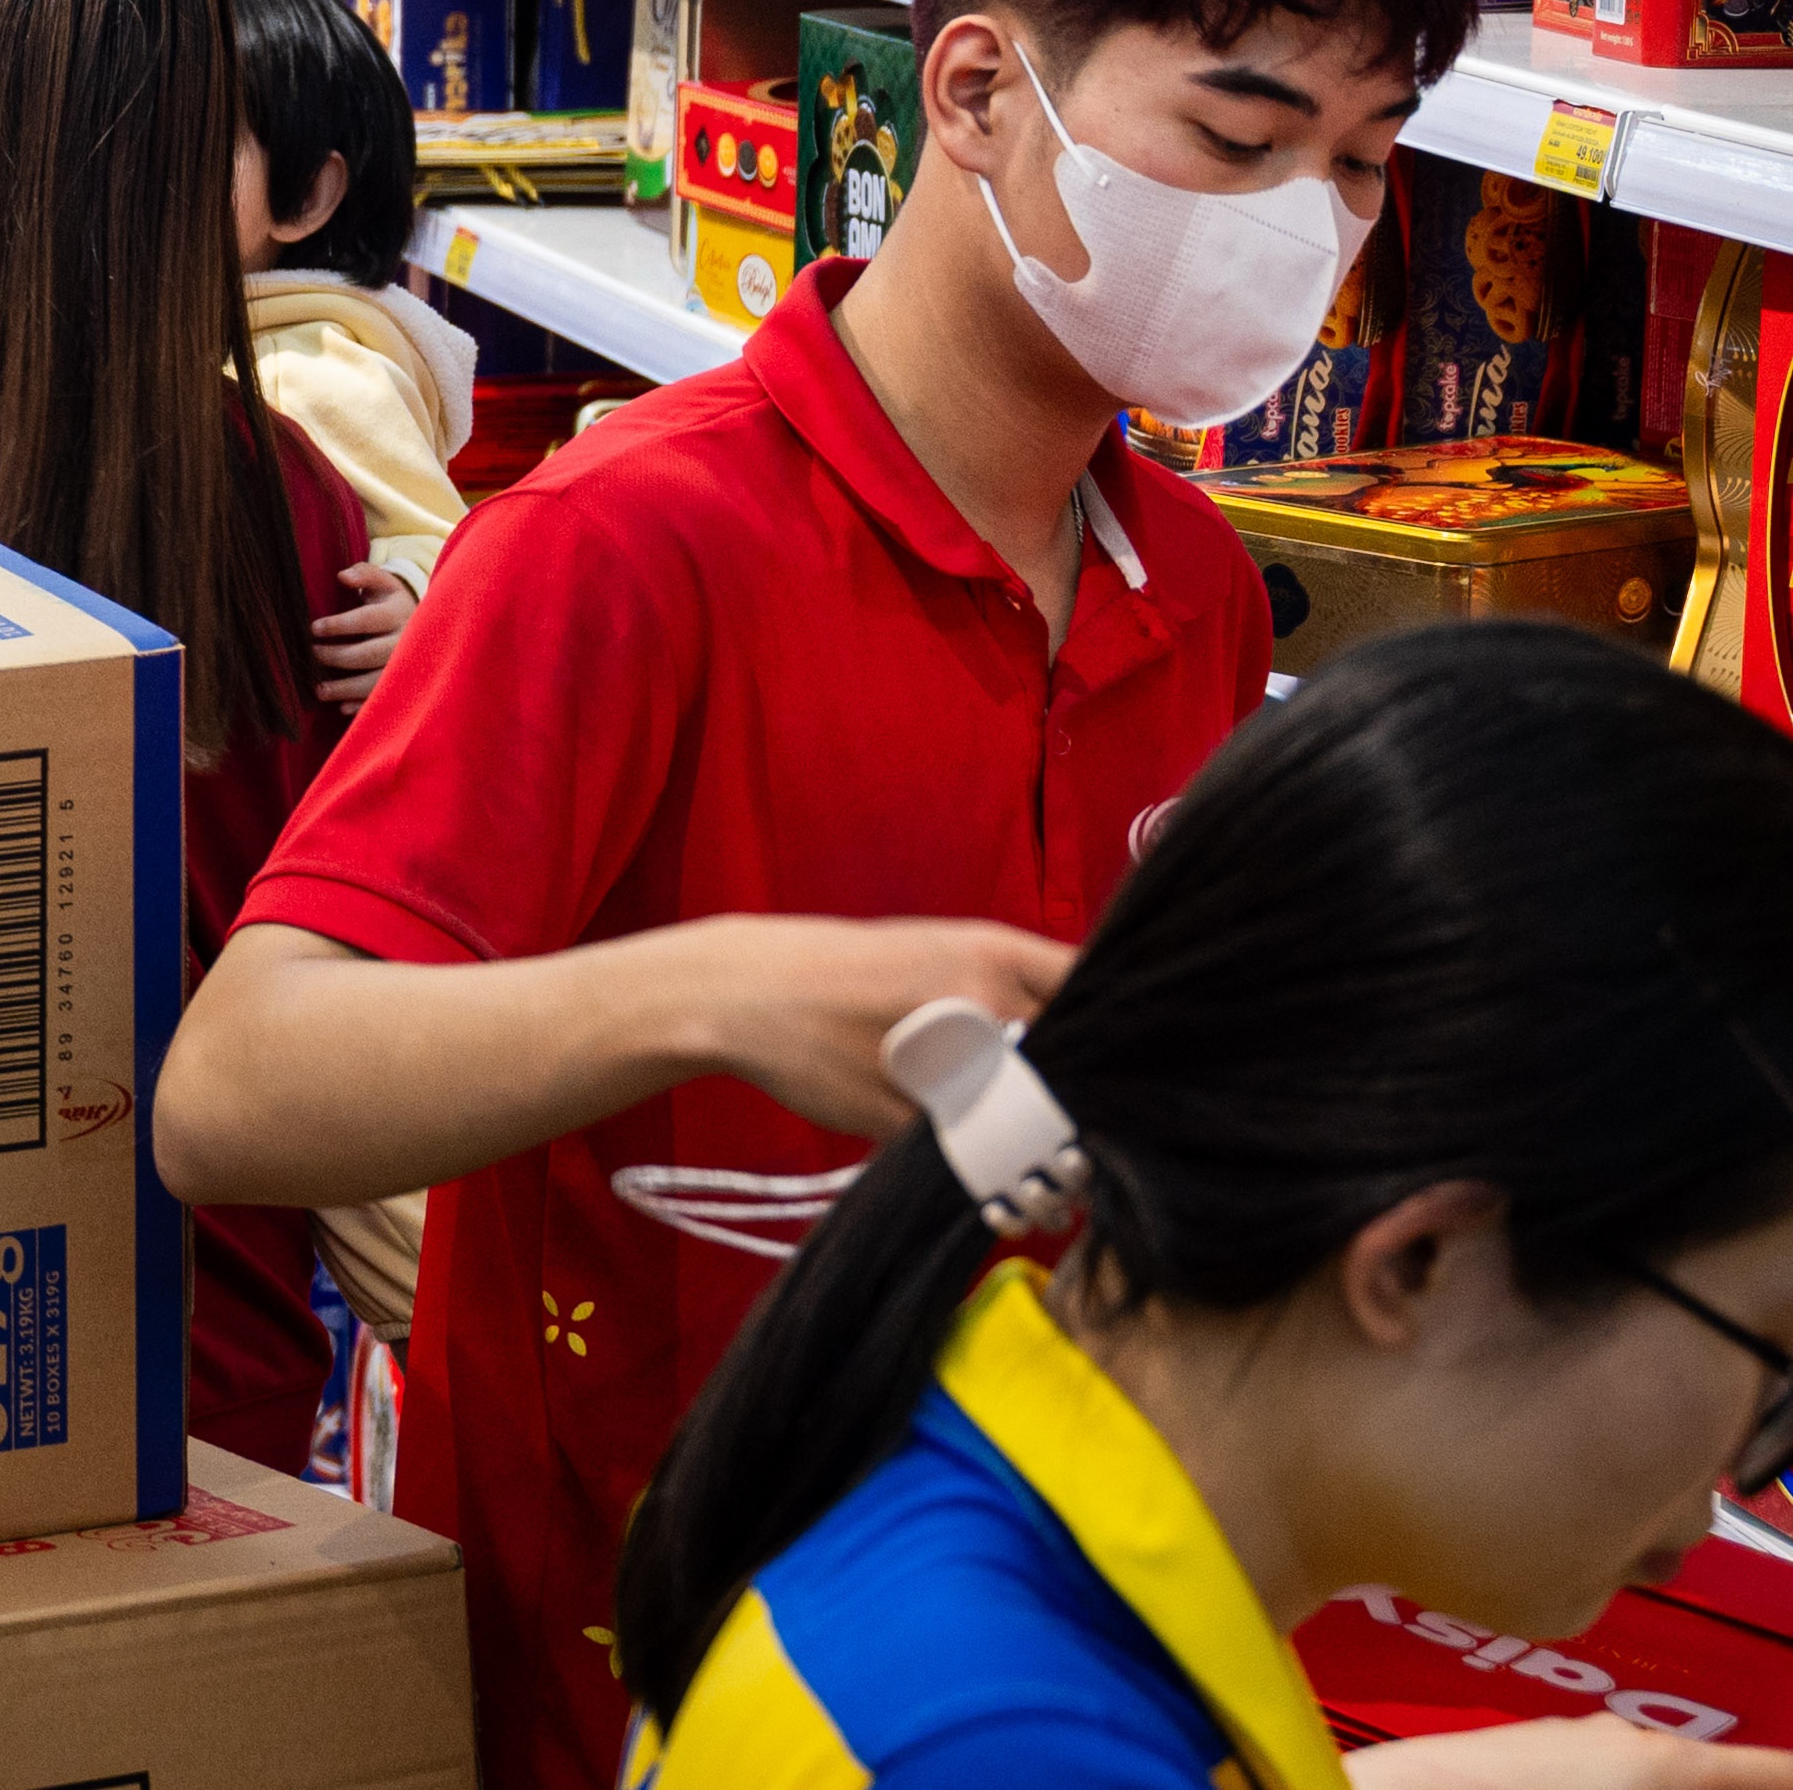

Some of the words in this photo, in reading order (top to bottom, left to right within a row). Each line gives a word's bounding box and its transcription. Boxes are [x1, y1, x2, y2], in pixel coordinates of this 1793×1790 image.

[848, 168, 886, 223] BON
[847, 218, 882, 260] AMI
[1261, 388, 1282, 441] topca
[1438, 360, 1459, 432] topcake
[1332, 407, 1351, 454] ookies
[44, 1269, 60, 1320] 319G
[46, 1323, 60, 1336] X
[17, 1359, 37, 1439] NETWT:
[46, 1342, 61, 1406] BOXES
[46, 1412, 61, 1434] 10
